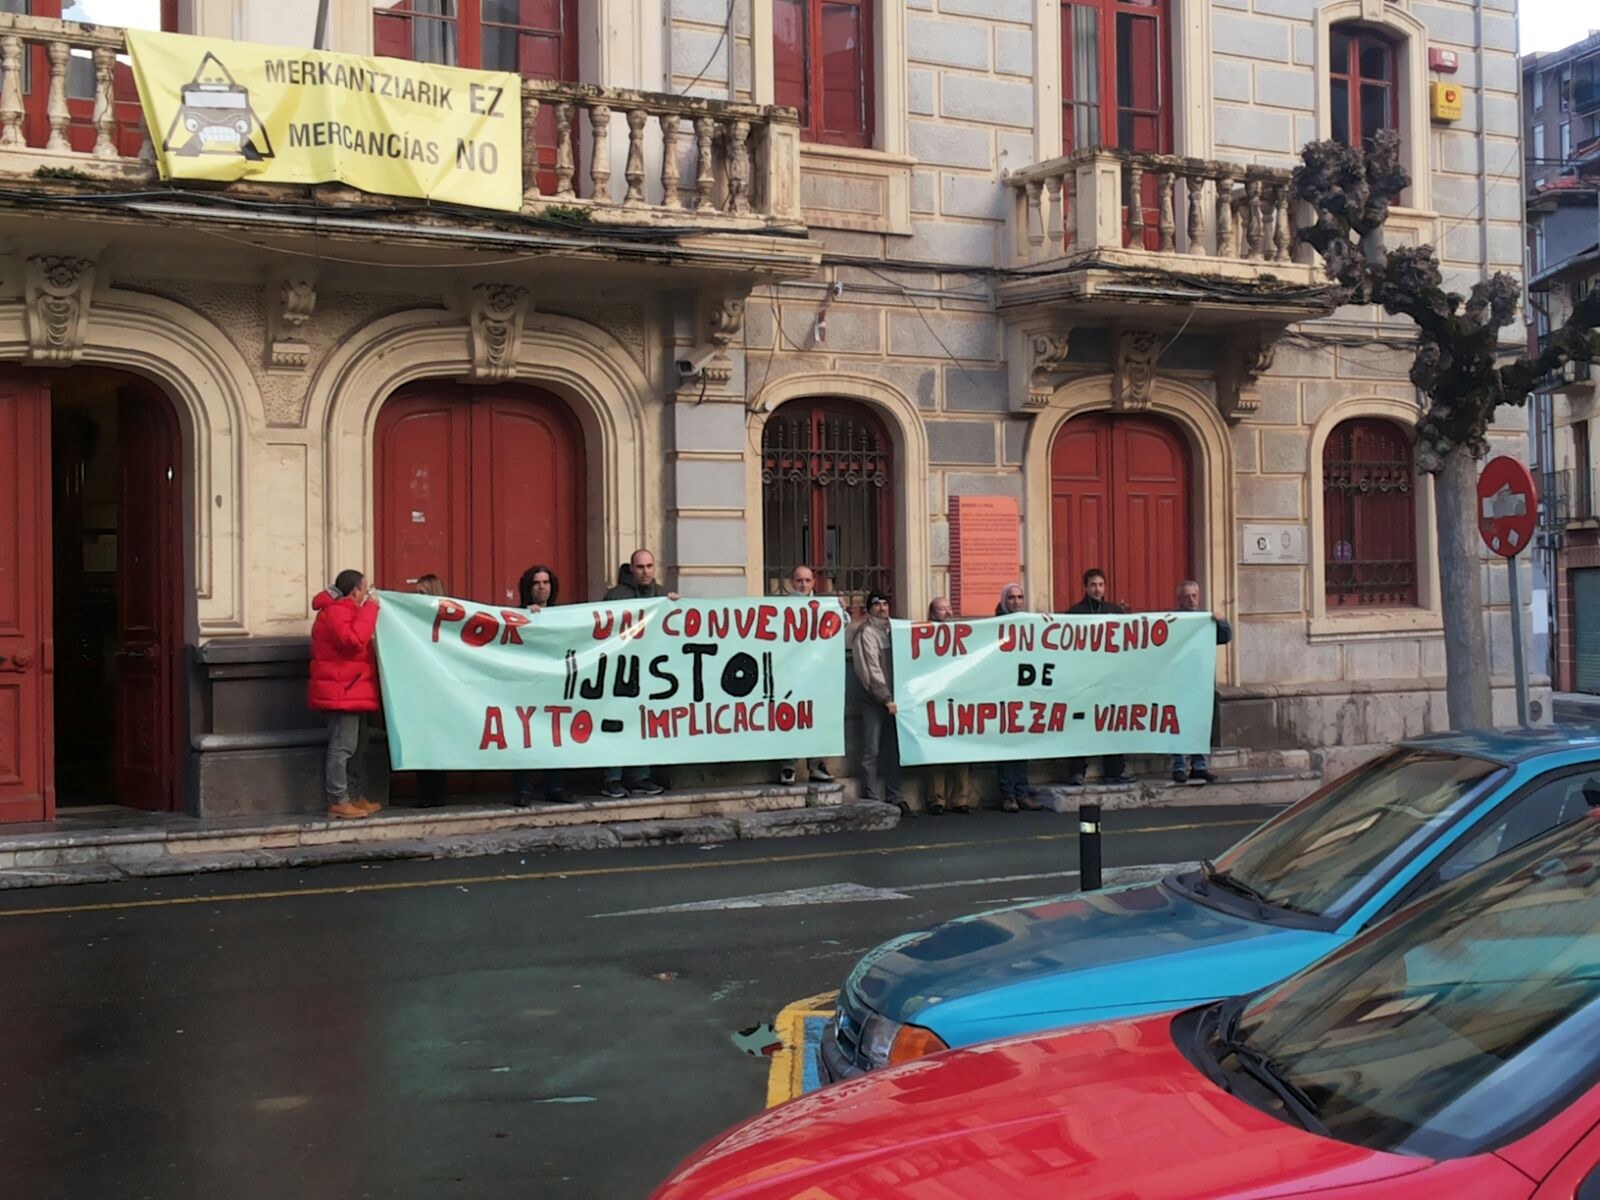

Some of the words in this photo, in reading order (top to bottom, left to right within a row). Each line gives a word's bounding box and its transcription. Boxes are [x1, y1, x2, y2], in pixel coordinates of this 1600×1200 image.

[264, 59, 453, 111] MERKANTZIARIK
[469, 82, 505, 118] EZ
[288, 121, 440, 165] MERCANCÍAS
[455, 136, 499, 175] NO
[431, 599, 533, 648] POR
[592, 608, 646, 642] UN
[661, 599, 843, 643] CONVENIO
[910, 621, 973, 660] POR
[998, 623, 1035, 652] UN
[1017, 663, 1056, 687] DE
[479, 705, 594, 750] AYTO
[638, 690, 814, 740] IMPLICACIÓN
[1094, 703, 1180, 735] VIARIA
